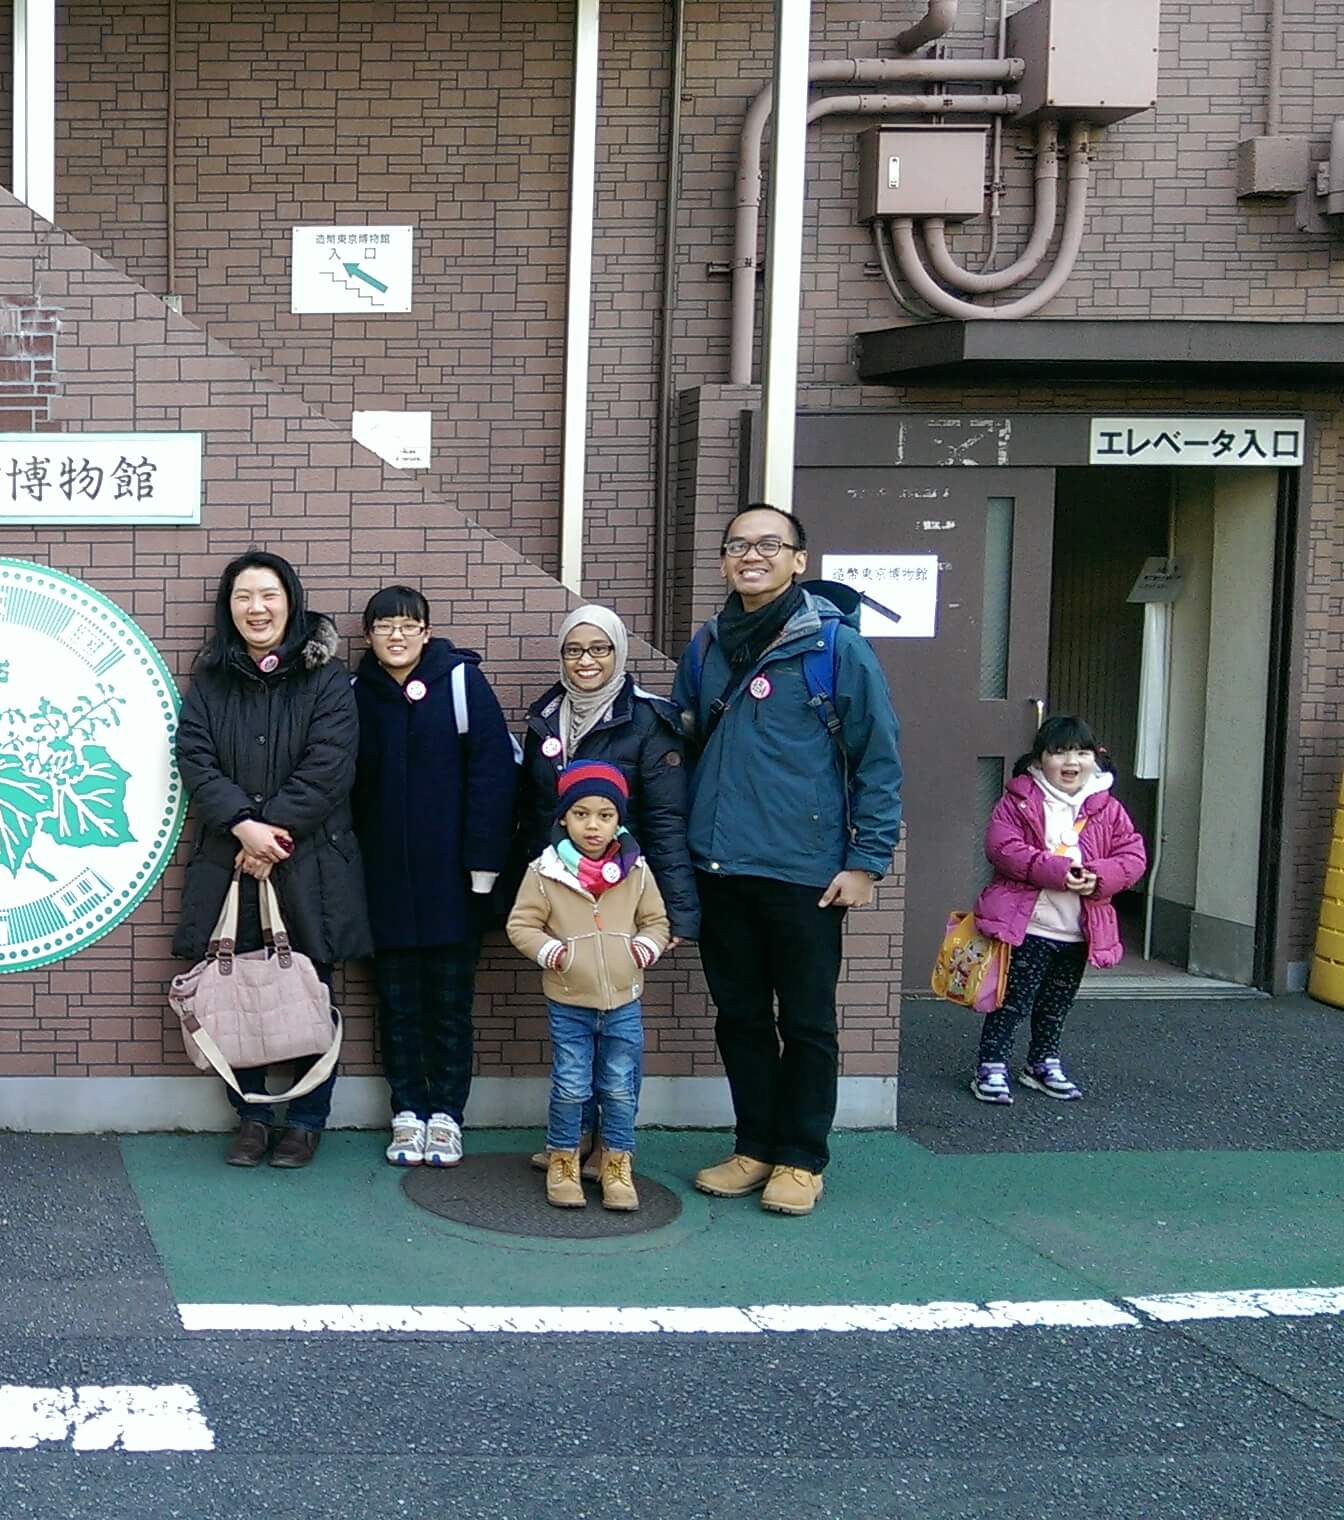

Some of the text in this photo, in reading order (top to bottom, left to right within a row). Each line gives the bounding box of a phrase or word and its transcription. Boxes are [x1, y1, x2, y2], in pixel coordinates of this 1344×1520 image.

[315, 233, 391, 245] 造幣東京博物館
[1098, 429, 1300, 458] エレベータ入口
[832, 567, 928, 582] 造幣東京博物館
